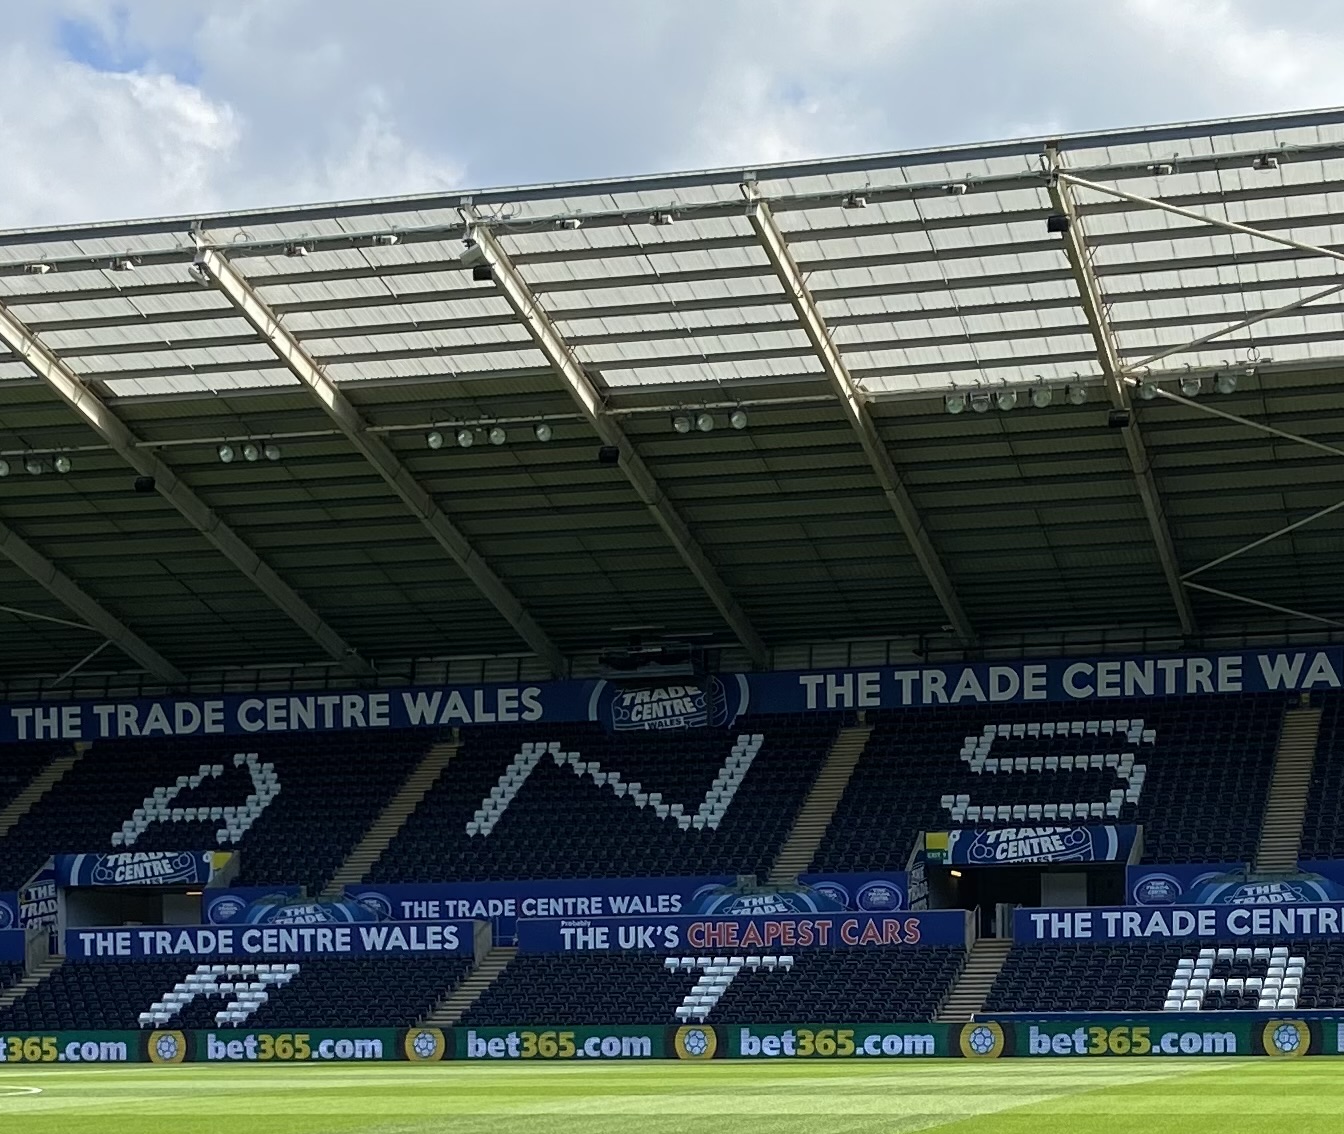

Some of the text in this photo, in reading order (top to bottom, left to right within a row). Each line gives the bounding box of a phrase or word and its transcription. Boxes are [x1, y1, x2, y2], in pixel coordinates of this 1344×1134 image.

[799, 674, 880, 708] THE
[895, 666, 1047, 705] TRADE
[1062, 656, 1242, 699] CENTRE
[622, 686, 702, 706] TRADE
[631, 697, 697, 721] CENTRE
[11, 687, 542, 739] THE TRADE CENTRE WALES
[648, 717, 681, 728] WALES
[996, 835, 1066, 860] CENTRE
[115, 859, 174, 882] CENTRE
[741, 895, 774, 906] THE
[1243, 883, 1281, 896] THE
[283, 905, 315, 916] THE
[401, 900, 440, 918] THE
[445, 898, 516, 917] TRADE
[521, 896, 603, 917] CENTRE
[608, 894, 683, 914] WALES
[560, 917, 921, 950] THE UK'S CHEAPEST CARS
[1030, 912, 1093, 939] THE
[1102, 910, 1216, 938] TRADE
[79, 925, 459, 956] THE TRADE CENTRE WALES
[207, 1033, 383, 1060] bet365.com
[467, 1030, 652, 1058] bet365.com
[740, 1027, 935, 1056] bet365.com
[1028, 1025, 1237, 1055] bet365.com
